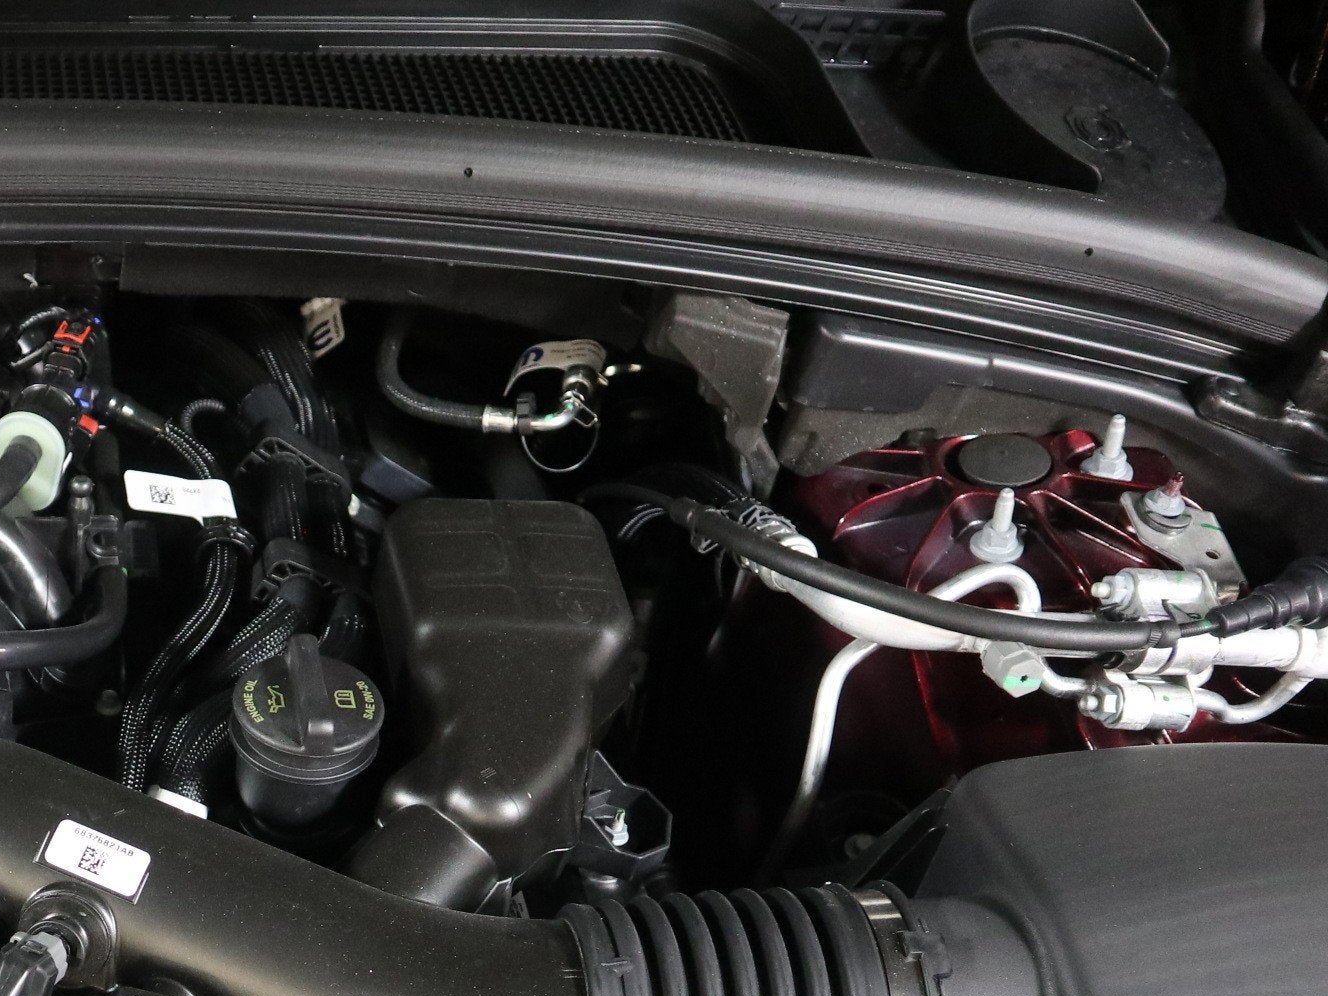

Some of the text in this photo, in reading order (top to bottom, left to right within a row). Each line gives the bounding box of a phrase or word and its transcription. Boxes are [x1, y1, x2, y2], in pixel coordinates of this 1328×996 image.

[243, 680, 264, 723] ENGINE OIL
[363, 704, 376, 720] SAE
